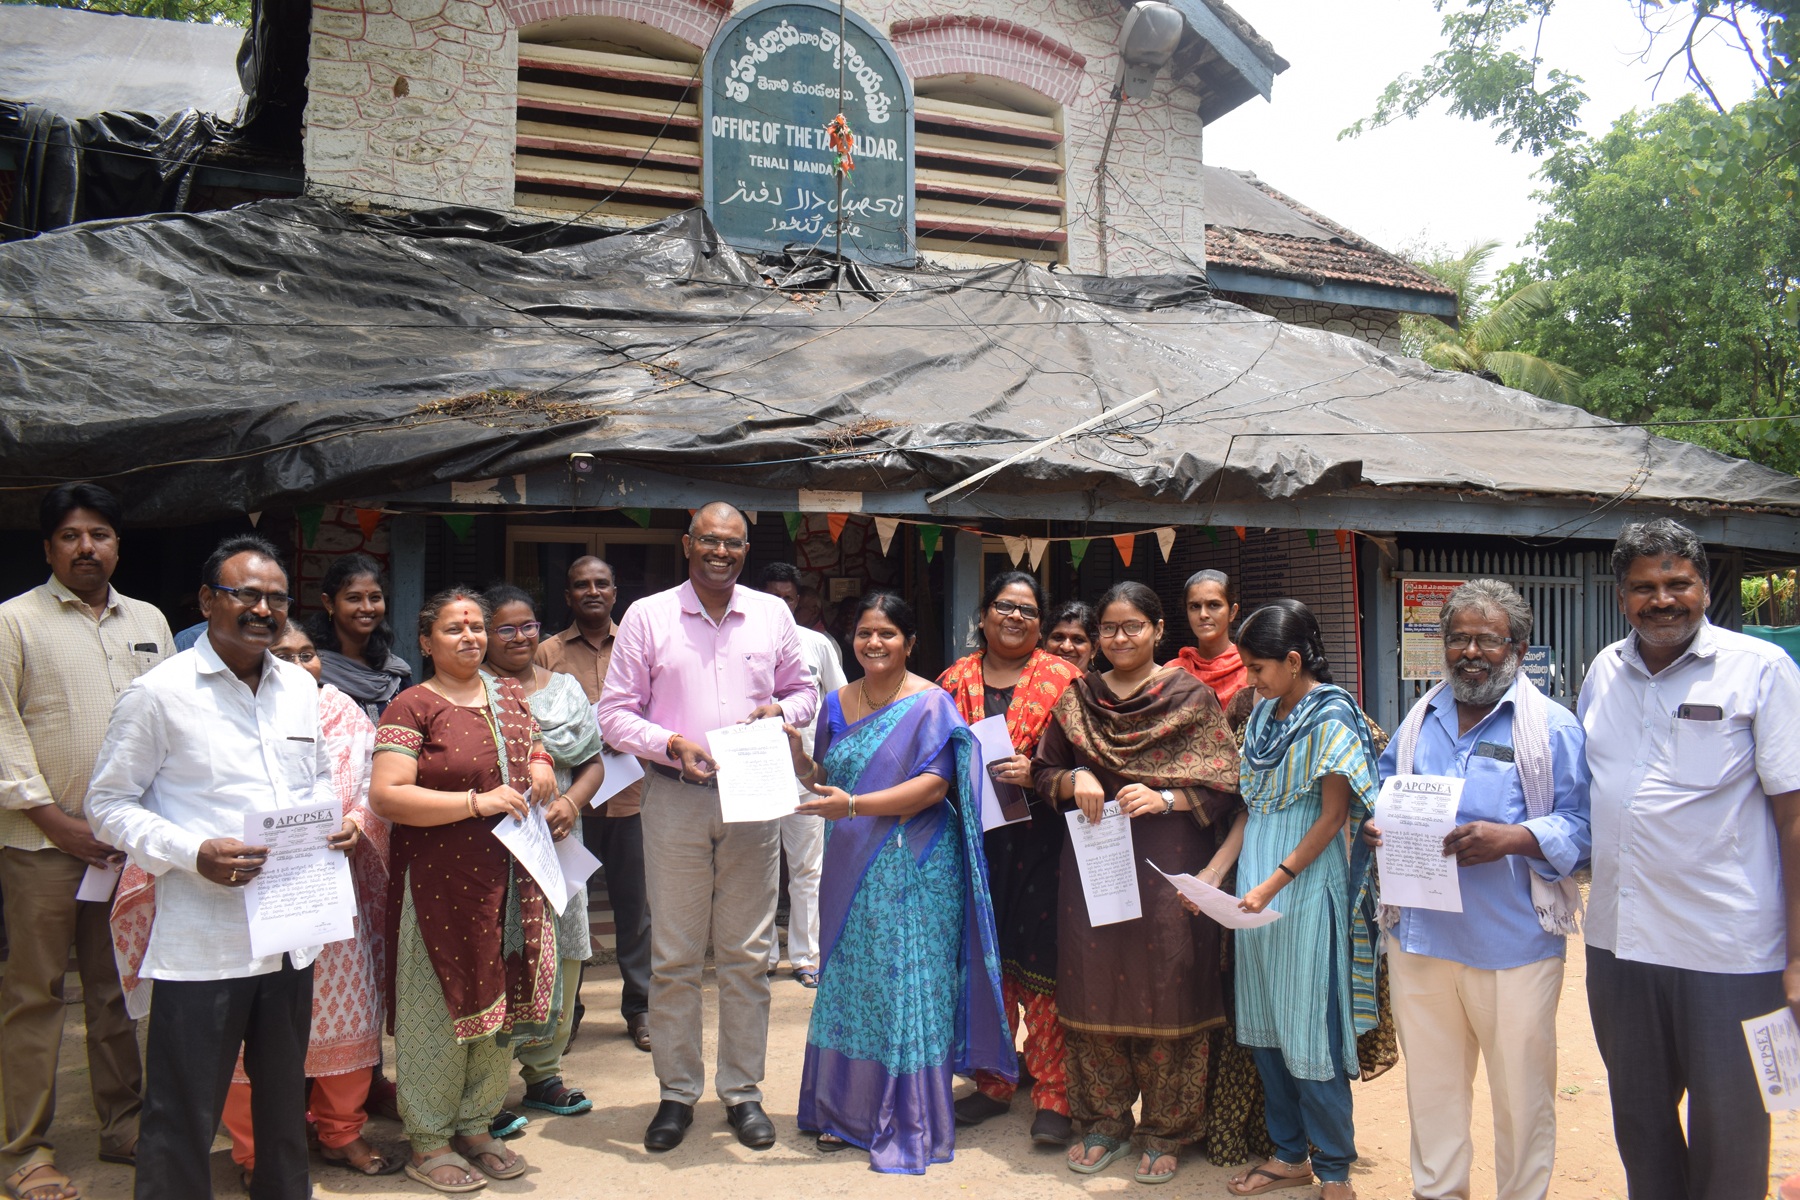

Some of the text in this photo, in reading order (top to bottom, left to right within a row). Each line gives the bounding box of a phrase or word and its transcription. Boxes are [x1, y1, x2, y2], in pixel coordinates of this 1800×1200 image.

[757, 75, 789, 92] తెనాలి
[711, 115, 761, 143] OFFICE
[762, 121, 780, 145] OF
[784, 125, 812, 149] THE
[749, 155, 837, 176] TENALI MANDA
[1404, 781, 1452, 793] APCPSEA
[277, 810, 333, 826] APCPSEA
[1757, 1026, 1778, 1081] APCPSEA
